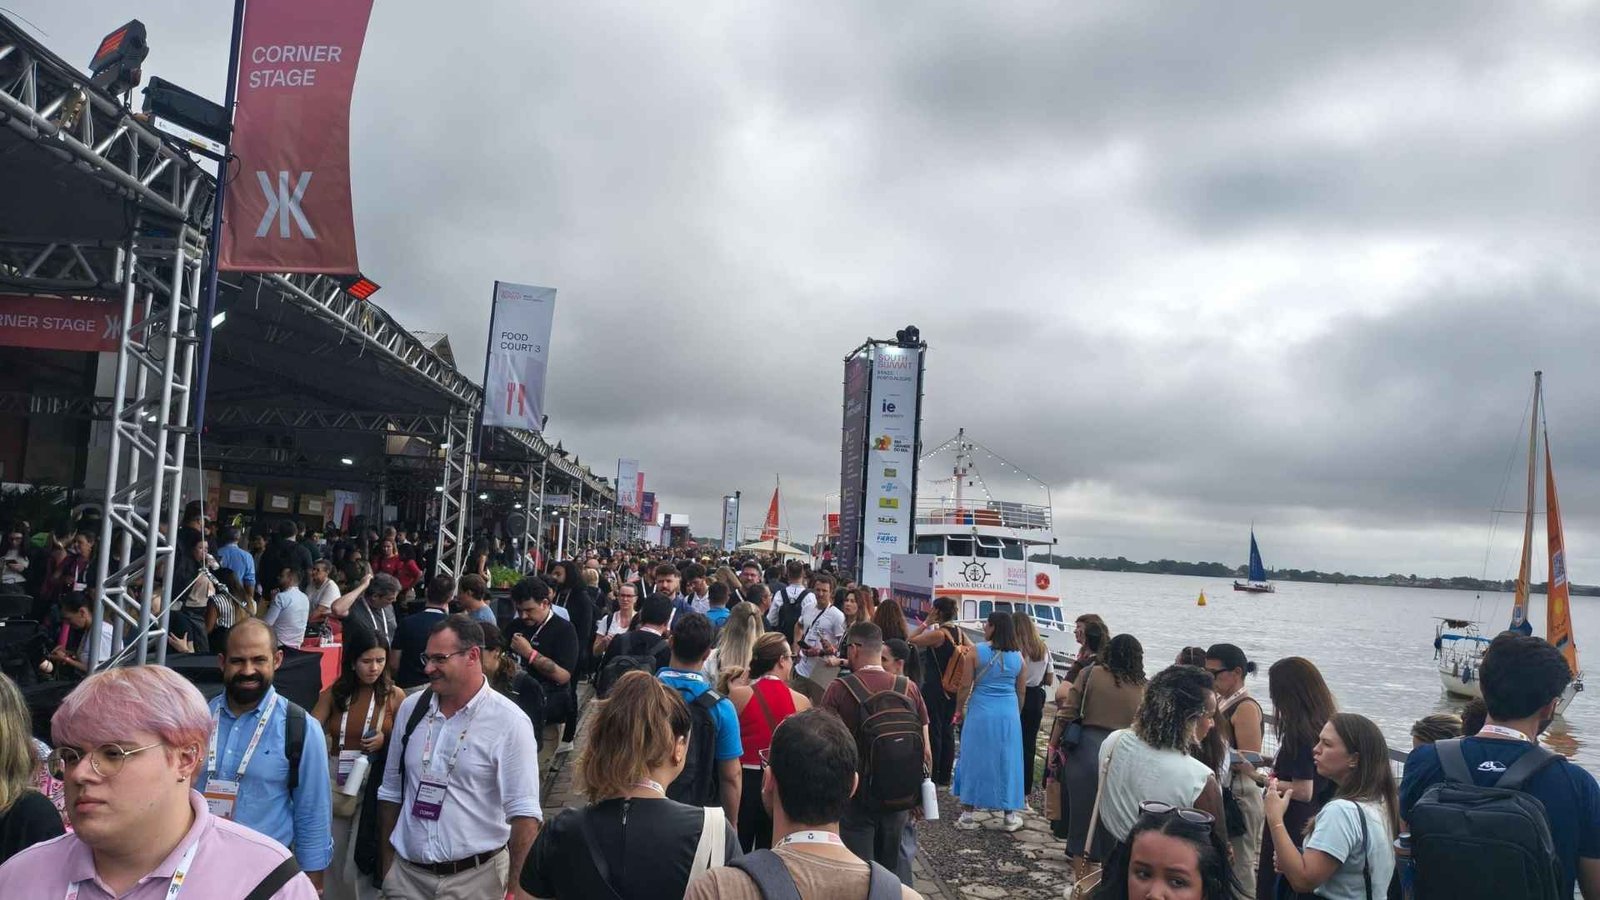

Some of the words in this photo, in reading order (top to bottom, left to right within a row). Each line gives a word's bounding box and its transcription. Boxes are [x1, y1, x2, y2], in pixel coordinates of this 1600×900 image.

[252, 45, 342, 64] CORNER
[249, 69, 316, 88] STAGE
[42, 316, 97, 332] STAGE
[501, 331, 529, 341] FOOD
[500, 341, 533, 352] COURT
[534, 345, 541, 353] 3
[882, 399, 896, 412] ie
